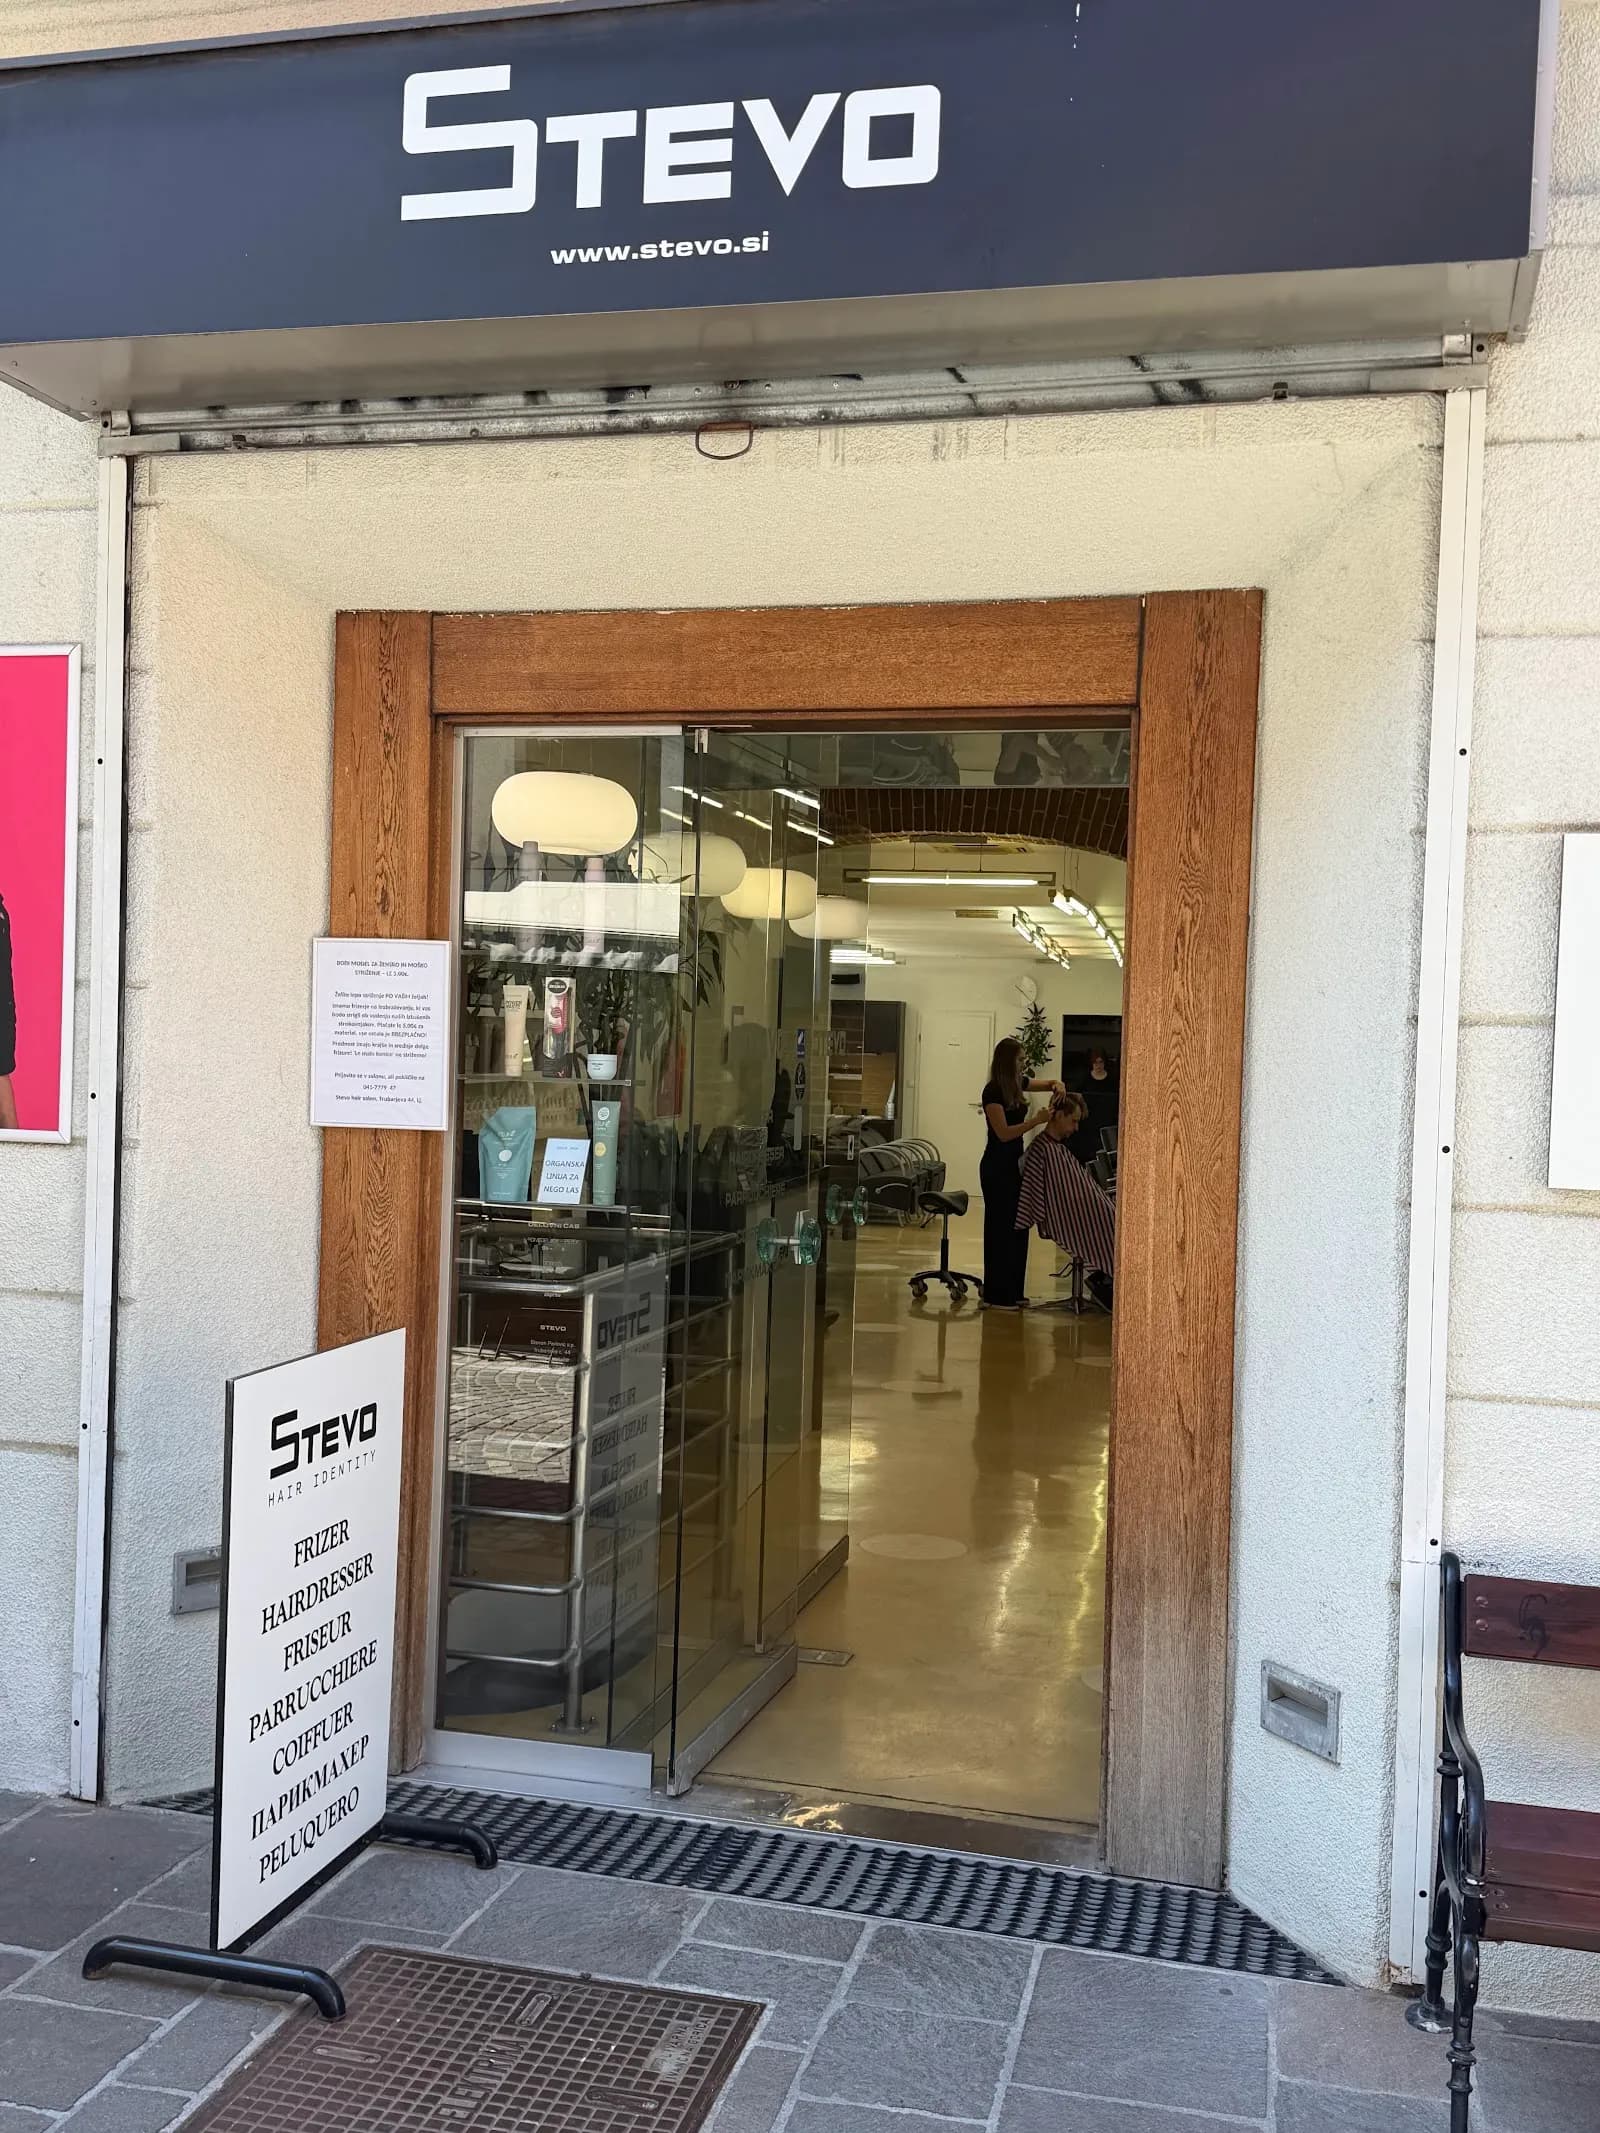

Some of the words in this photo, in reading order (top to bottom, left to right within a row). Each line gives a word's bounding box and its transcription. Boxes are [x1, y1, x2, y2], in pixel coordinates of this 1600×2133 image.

[400, 64, 942, 221] STEVO
[550, 231, 769, 265] www.stevo.si
[545, 1160, 584, 1168] ORGANSKA
[539, 1324, 567, 1332] STEVO
[269, 1402, 377, 1480] STEVO
[267, 1481, 303, 1509] HAIR
[313, 1449, 376, 1489] IDENTITY
[294, 1519, 350, 1568] FRIZER
[261, 1552, 375, 1635] HAIRDRESSER
[283, 1611, 352, 1672] FRISEUR
[248, 1640, 377, 1743] PARRUCCHIERE
[272, 1701, 354, 1776] COIFFUER
[250, 1734, 370, 1841] ПАРИКМАХЕР
[259, 1786, 360, 1884] PELUQUERO
